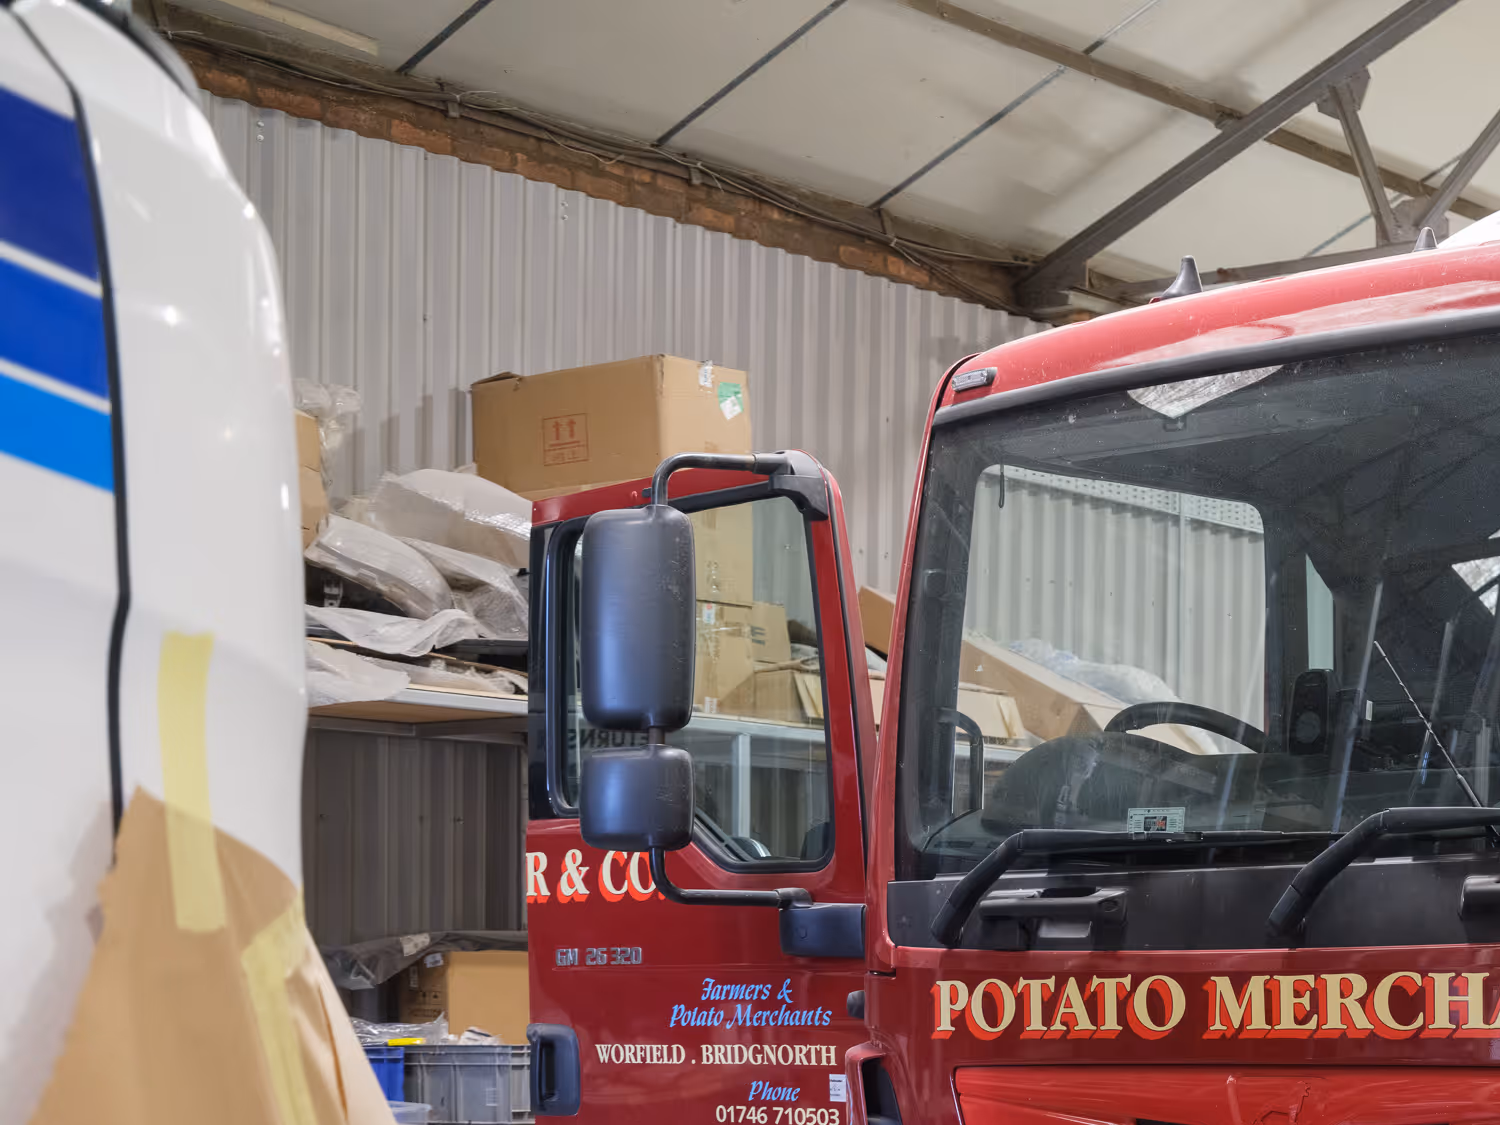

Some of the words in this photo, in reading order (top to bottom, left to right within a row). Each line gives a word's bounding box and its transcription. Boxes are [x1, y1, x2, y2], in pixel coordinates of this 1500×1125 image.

[556, 848, 590, 903] &
[585, 946, 607, 966] 26
[610, 946, 642, 965] 320
[701, 977, 771, 1001] Farmers
[777, 977, 794, 1003] &
[669, 1004, 724, 1028] Potato
[726, 1003, 833, 1029] Merchants
[931, 974, 1187, 1041] POTATO
[595, 1043, 686, 1065] WORFIELD
[701, 1043, 838, 1066] BRIDGNORTH
[748, 1080, 801, 1102] Phone
[715, 1105, 768, 1125] 01746
